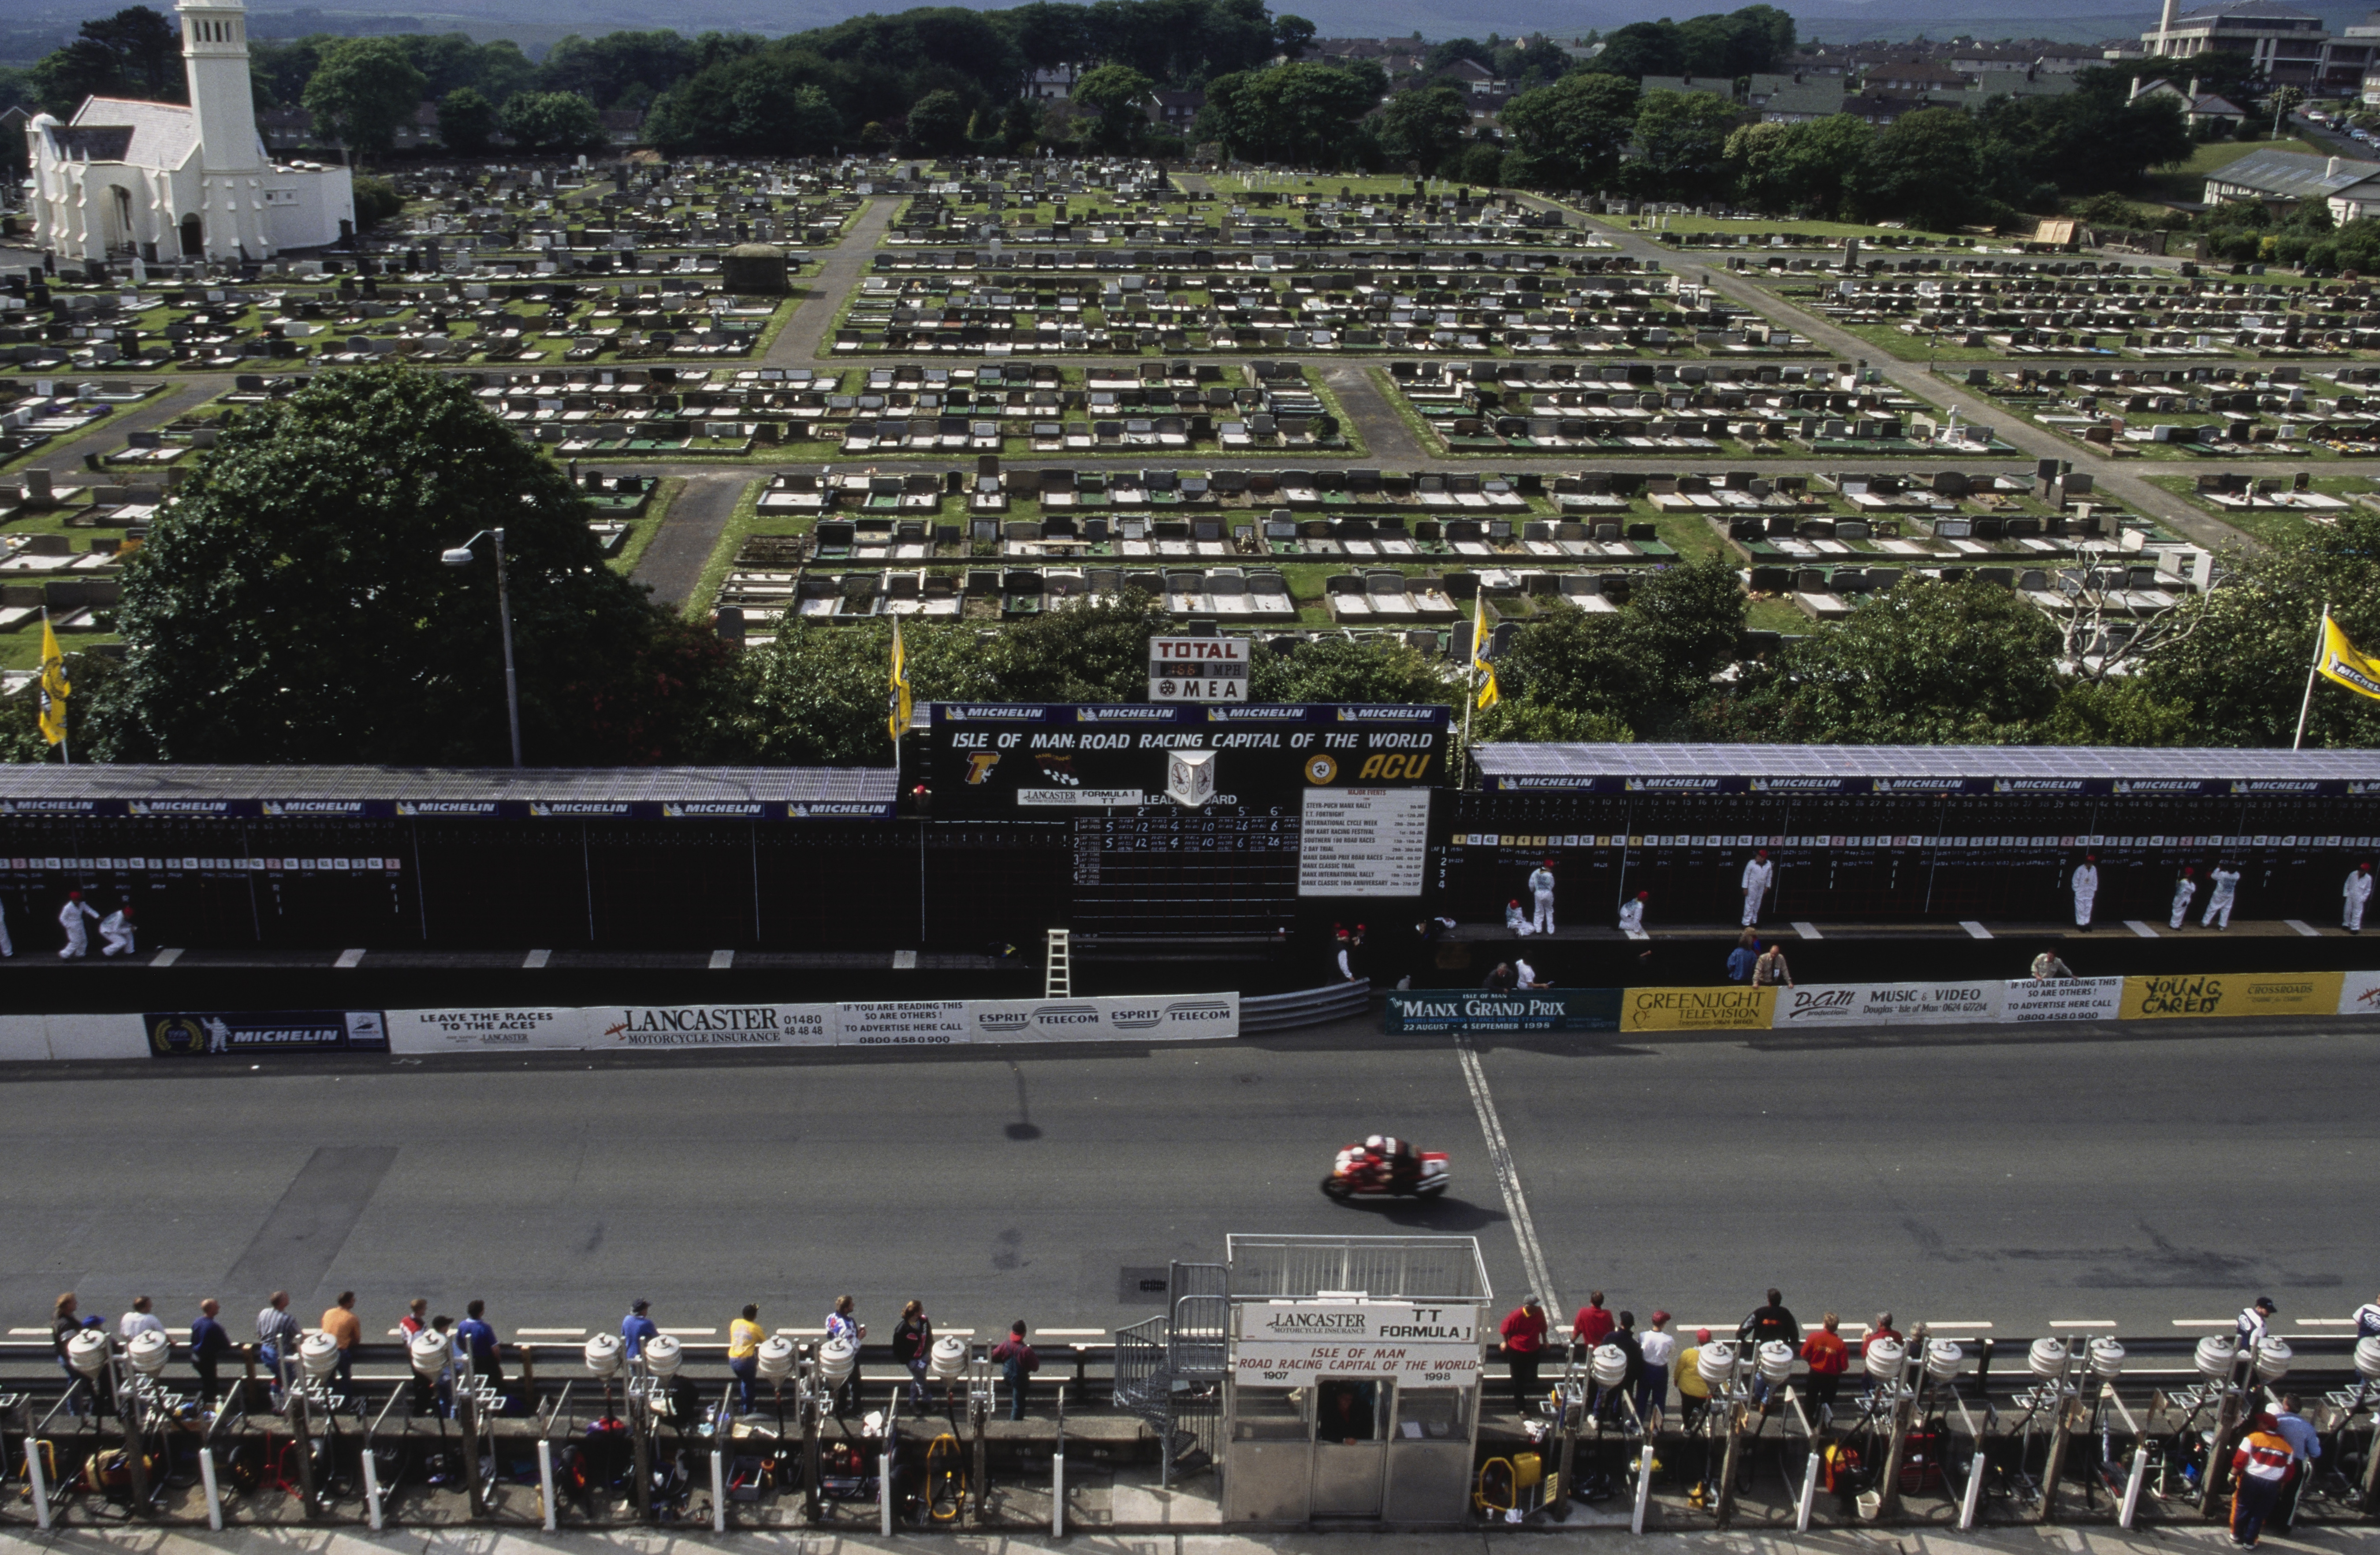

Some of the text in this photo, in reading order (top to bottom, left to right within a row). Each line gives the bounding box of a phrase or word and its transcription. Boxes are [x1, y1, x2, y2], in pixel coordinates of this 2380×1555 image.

[1158, 642, 1238, 658] TOTAL
[1213, 664, 1242, 676] MPH
[2337, 666, 2380, 692] MICHEL
[1183, 680, 1238, 698] MEA
[967, 707, 1043, 718] MICHELIN
[1098, 709, 1173, 718] MICHELIN
[1229, 708, 1304, 717] MICHELIN
[1359, 709, 1432, 718] MICHELIN
[952, 733, 1432, 749] ISLE OF MAN: ROAD RACING CAPITAL OF THE WORLD
[1359, 754, 1431, 778] ACU
[1519, 778, 1593, 787] MICHELIN
[1646, 778, 1718, 788] MICHELIN
[1770, 778, 1841, 788] MICHELIN
[1892, 779, 1963, 789] MICHELIN
[2013, 780, 2082, 790] MICHELIN
[2132, 781, 2201, 790] MICHELIN
[2250, 781, 2318, 791] MICHELIN
[16, 801, 94, 810] MICHELIN
[150, 801, 227, 811] MICHELIN
[285, 802, 361, 811] MICHELIN
[418, 802, 495, 812] MICHELIN
[551, 803, 628, 813] MICHELIN
[685, 804, 761, 813] MICHELIN
[810, 804, 886, 813] MICHELIN
[2248, 986, 2313, 994] CROSSROADS
[1637, 992, 1765, 1009] GREENLIGHT
[1870, 989, 1981, 1002] MUSIC & VIDEO
[1390, 997, 1565, 1017] The MANX GRAND PRIX
[1863, 1004, 1893, 1015] Douglas
[1898, 1004, 1911, 1013] Isle
[1912, 1004, 1920, 1013] of
[1922, 1003, 1938, 1012] Man
[421, 1014, 466, 1023] LEAVE
[979, 1013, 1099, 1024] ESPRIT TELECOM
[1111, 1010, 1230, 1021] ESPRIT TELECOM
[1678, 1008, 1760, 1019] TELEVISION
[625, 1008, 779, 1032] LANCASTER
[784, 1015, 821, 1024] 01480
[785, 1027, 795, 1035] 48
[812, 1026, 823, 1034] 48
[233, 1030, 339, 1043] MICHELIN
[628, 1033, 780, 1044] MOTORCYCLE INSURANCE
[1275, 1313, 1365, 1327] LANCASTER
[1380, 1326, 1471, 1338] FORMULA 1
[1311, 1348, 1406, 1358] ISLE OF MAN
[1239, 1358, 1476, 1371] ROAD RACING CAPITAL OF THE WORLD
[1263, 1371, 1289, 1380] 1907
[1424, 1372, 1451, 1381] 1998
